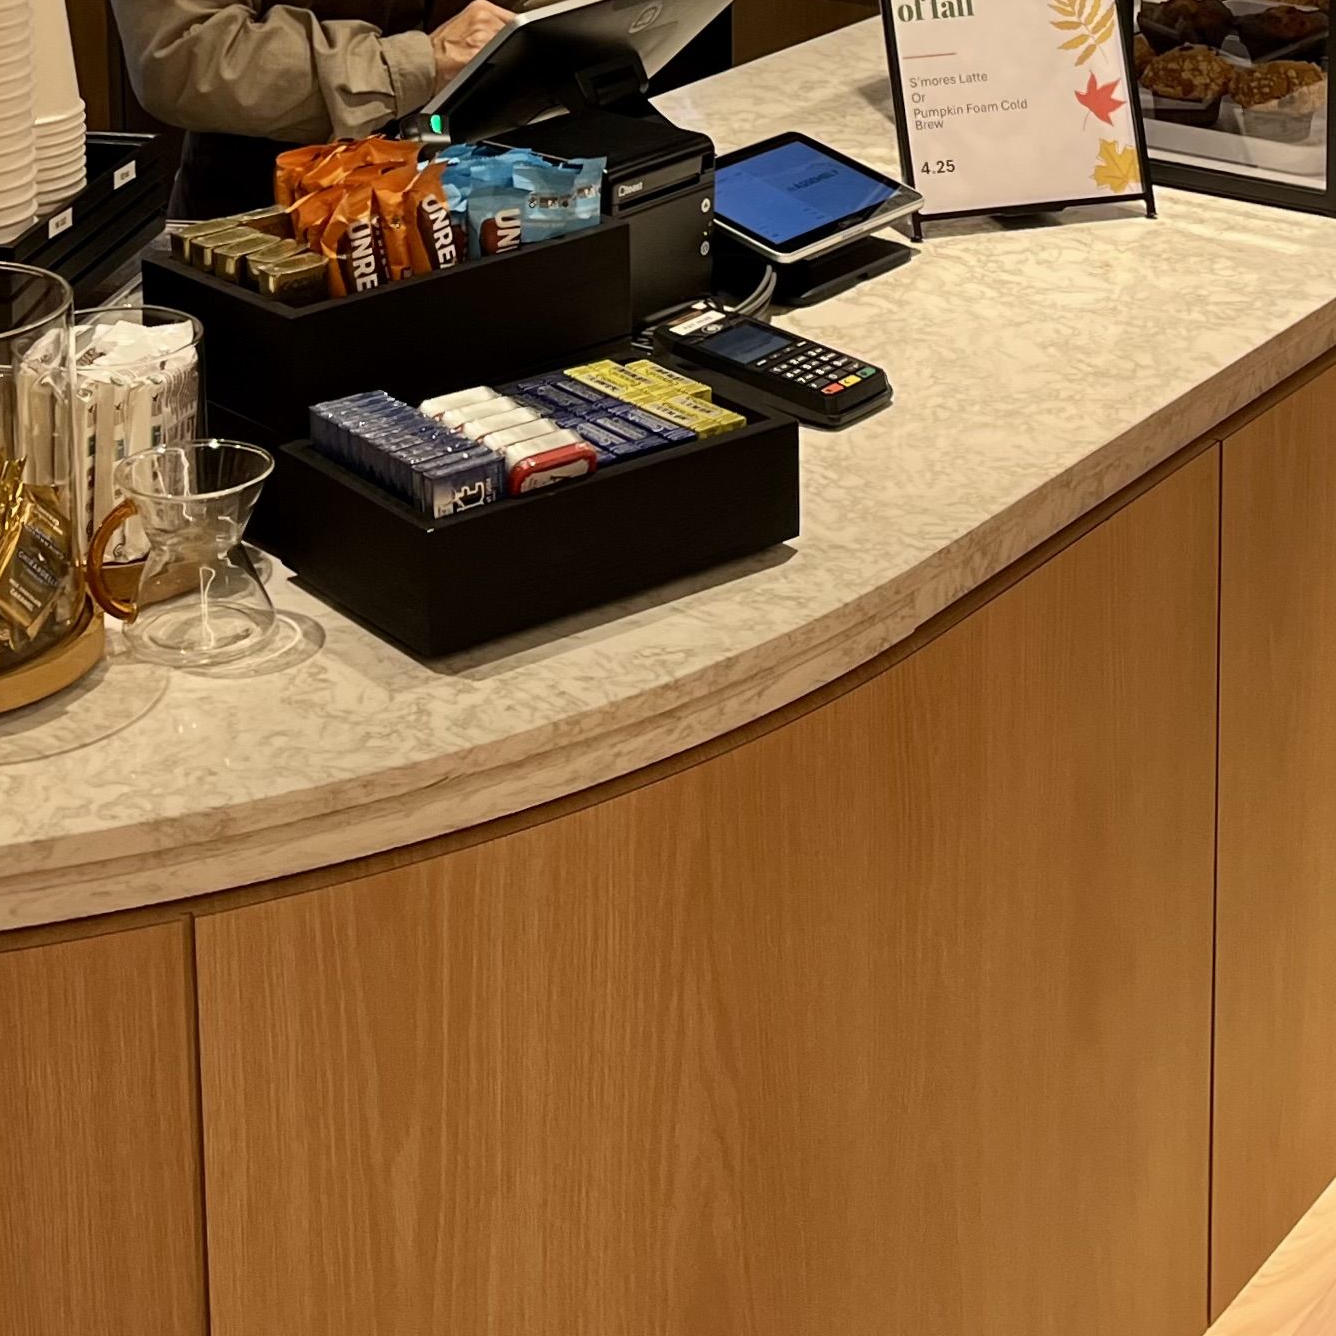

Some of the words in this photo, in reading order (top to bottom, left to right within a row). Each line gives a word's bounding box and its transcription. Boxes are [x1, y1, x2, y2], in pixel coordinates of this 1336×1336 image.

[909, 74, 957, 89] S'mores
[958, 71, 989, 84] Latte
[911, 92, 926, 104] Or
[913, 103, 965, 121] Pumpkin
[966, 102, 999, 115] Foam
[1000, 98, 1029, 111] Cold
[915, 118, 945, 131] Brew
[920, 159, 956, 176] 4.25
